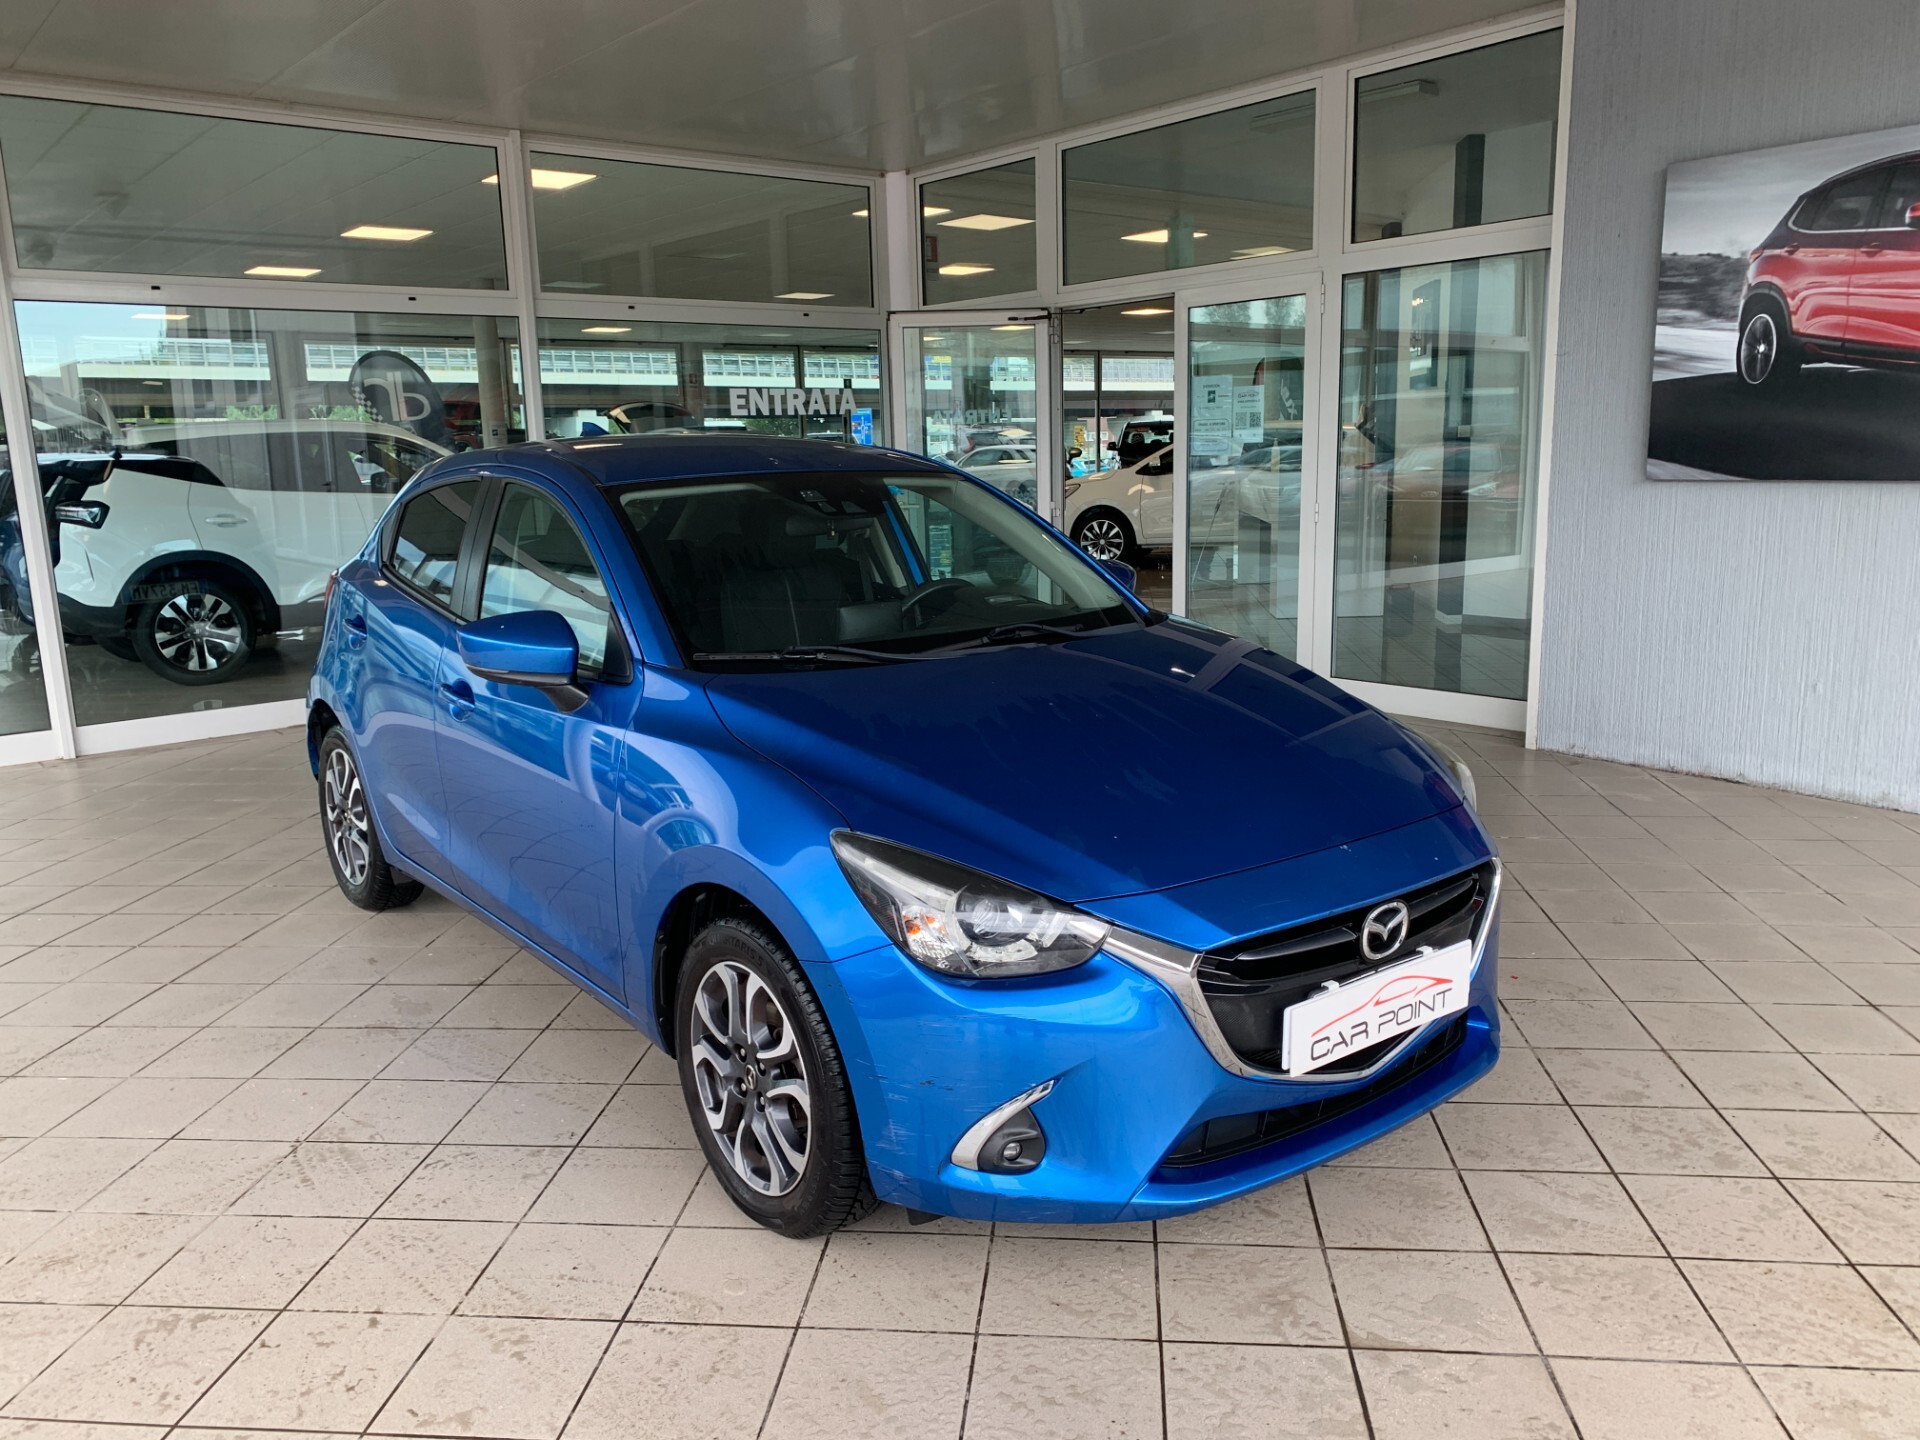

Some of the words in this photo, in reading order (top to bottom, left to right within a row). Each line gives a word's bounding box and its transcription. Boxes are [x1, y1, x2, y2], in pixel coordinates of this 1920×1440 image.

[729, 387, 857, 416] ENTRATA
[1310, 1021, 1369, 1062] CAR
[1378, 988, 1453, 1034] POINT
